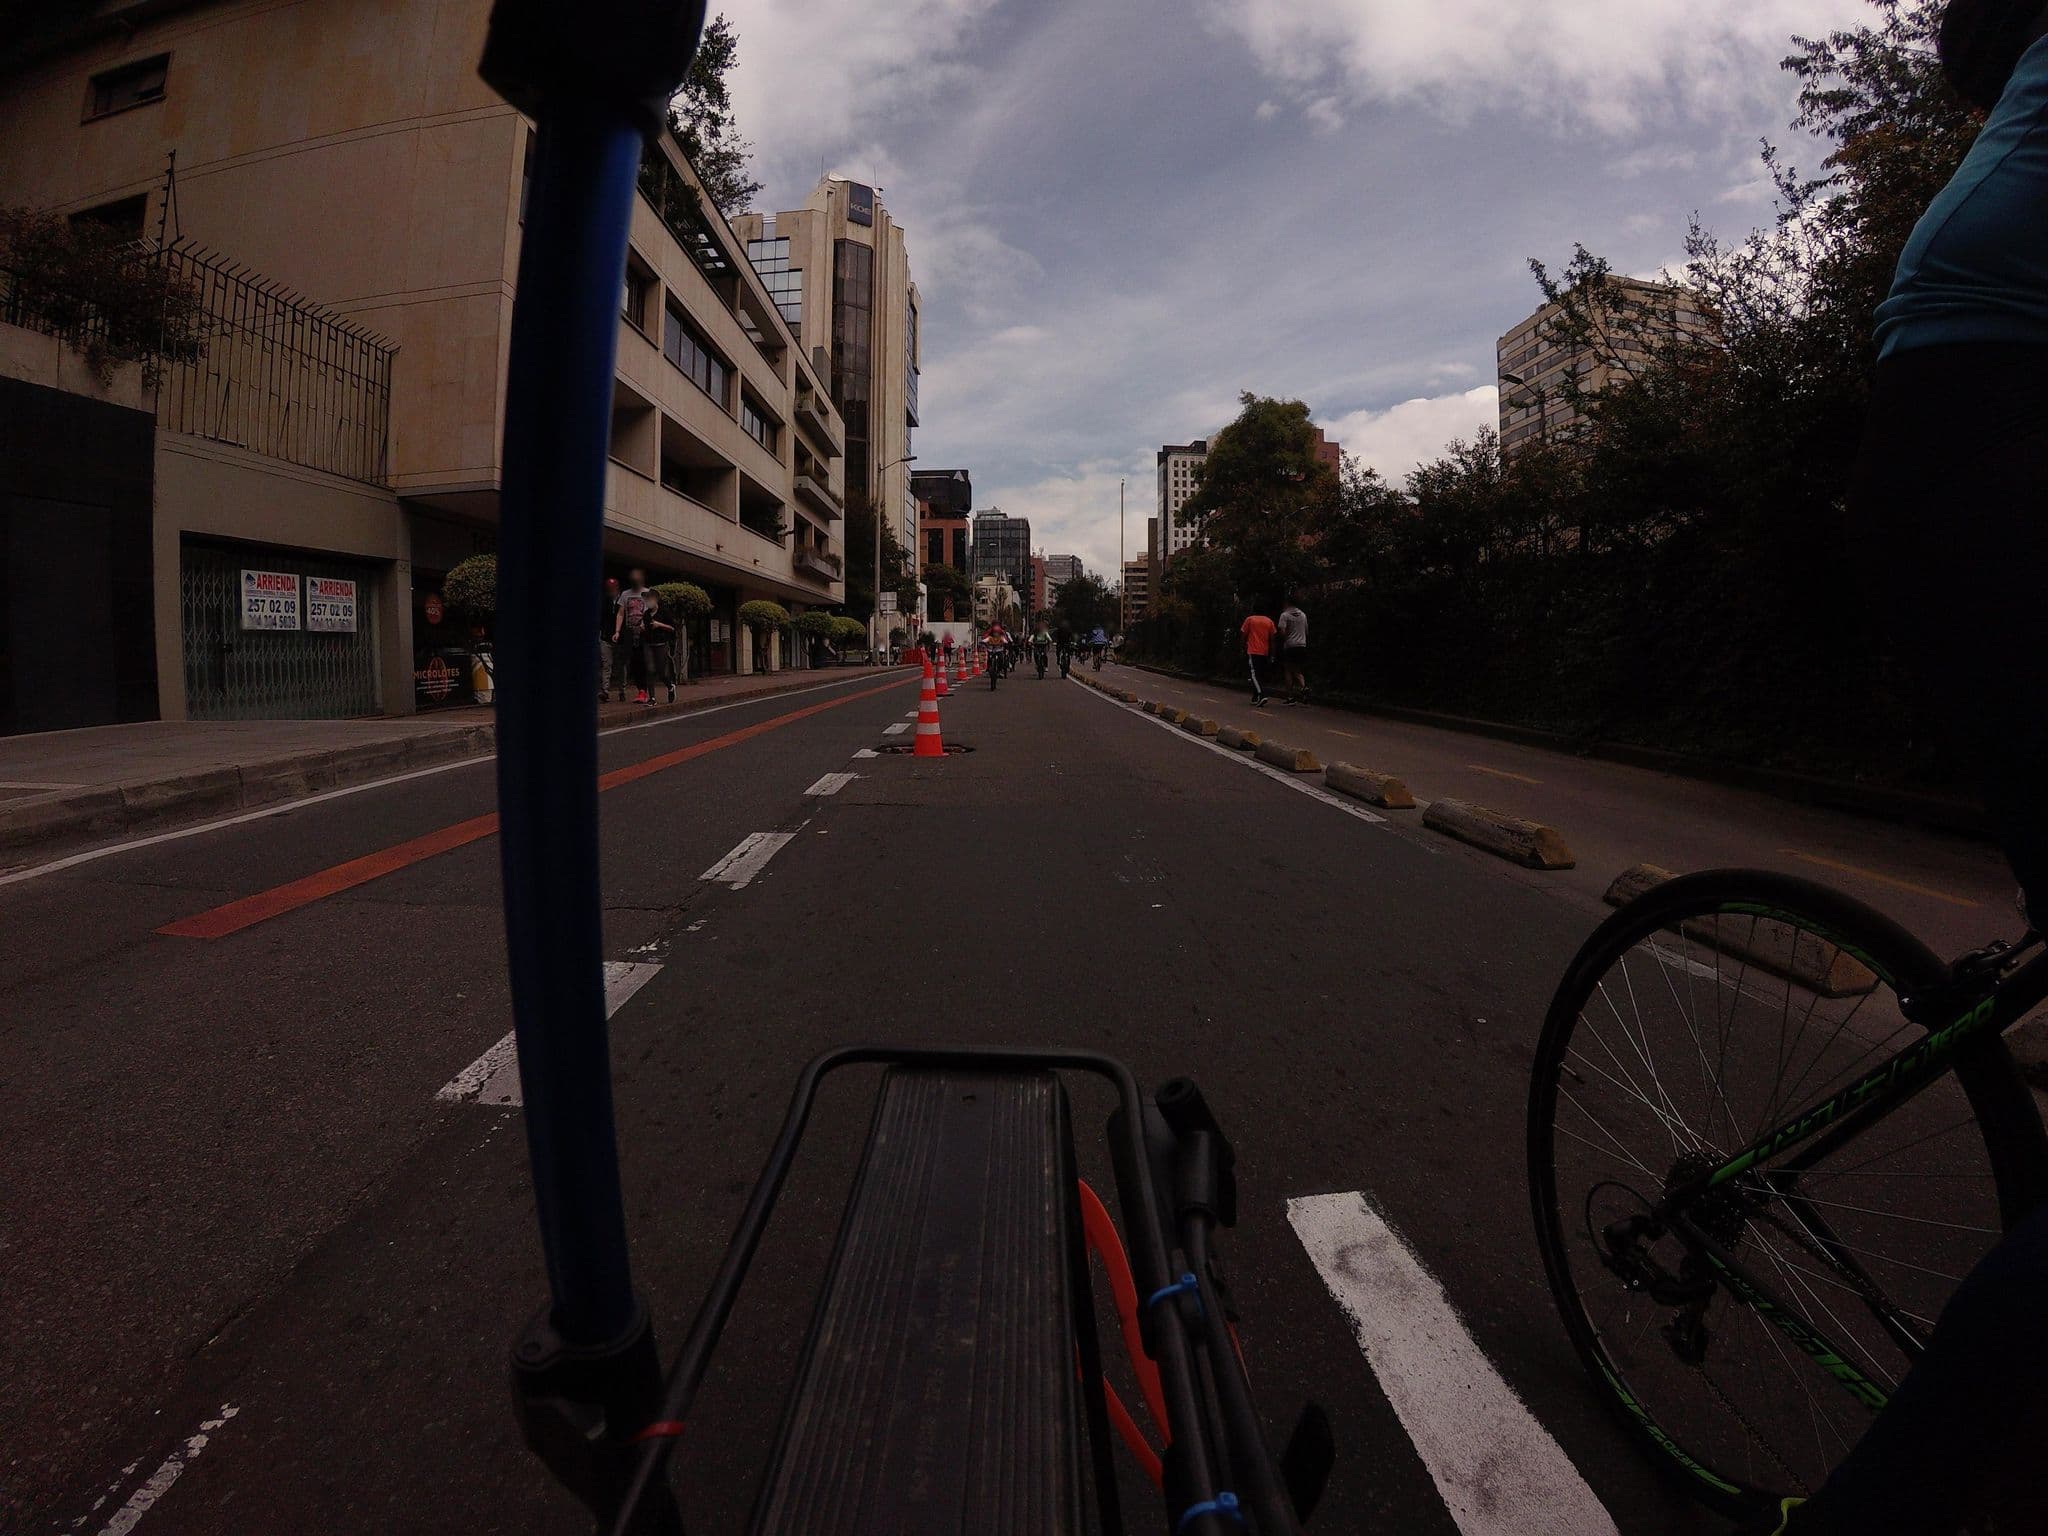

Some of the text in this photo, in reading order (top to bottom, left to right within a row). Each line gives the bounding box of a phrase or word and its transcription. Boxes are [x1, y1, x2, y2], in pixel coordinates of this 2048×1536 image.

[256, 574, 296, 591] ARRIENDA
[319, 580, 353, 597] ARRIENDA
[248, 599, 296, 614] 257 02 09
[311, 603, 353, 617] 257 02 09
[413, 667, 460, 680] MICROLOTES
